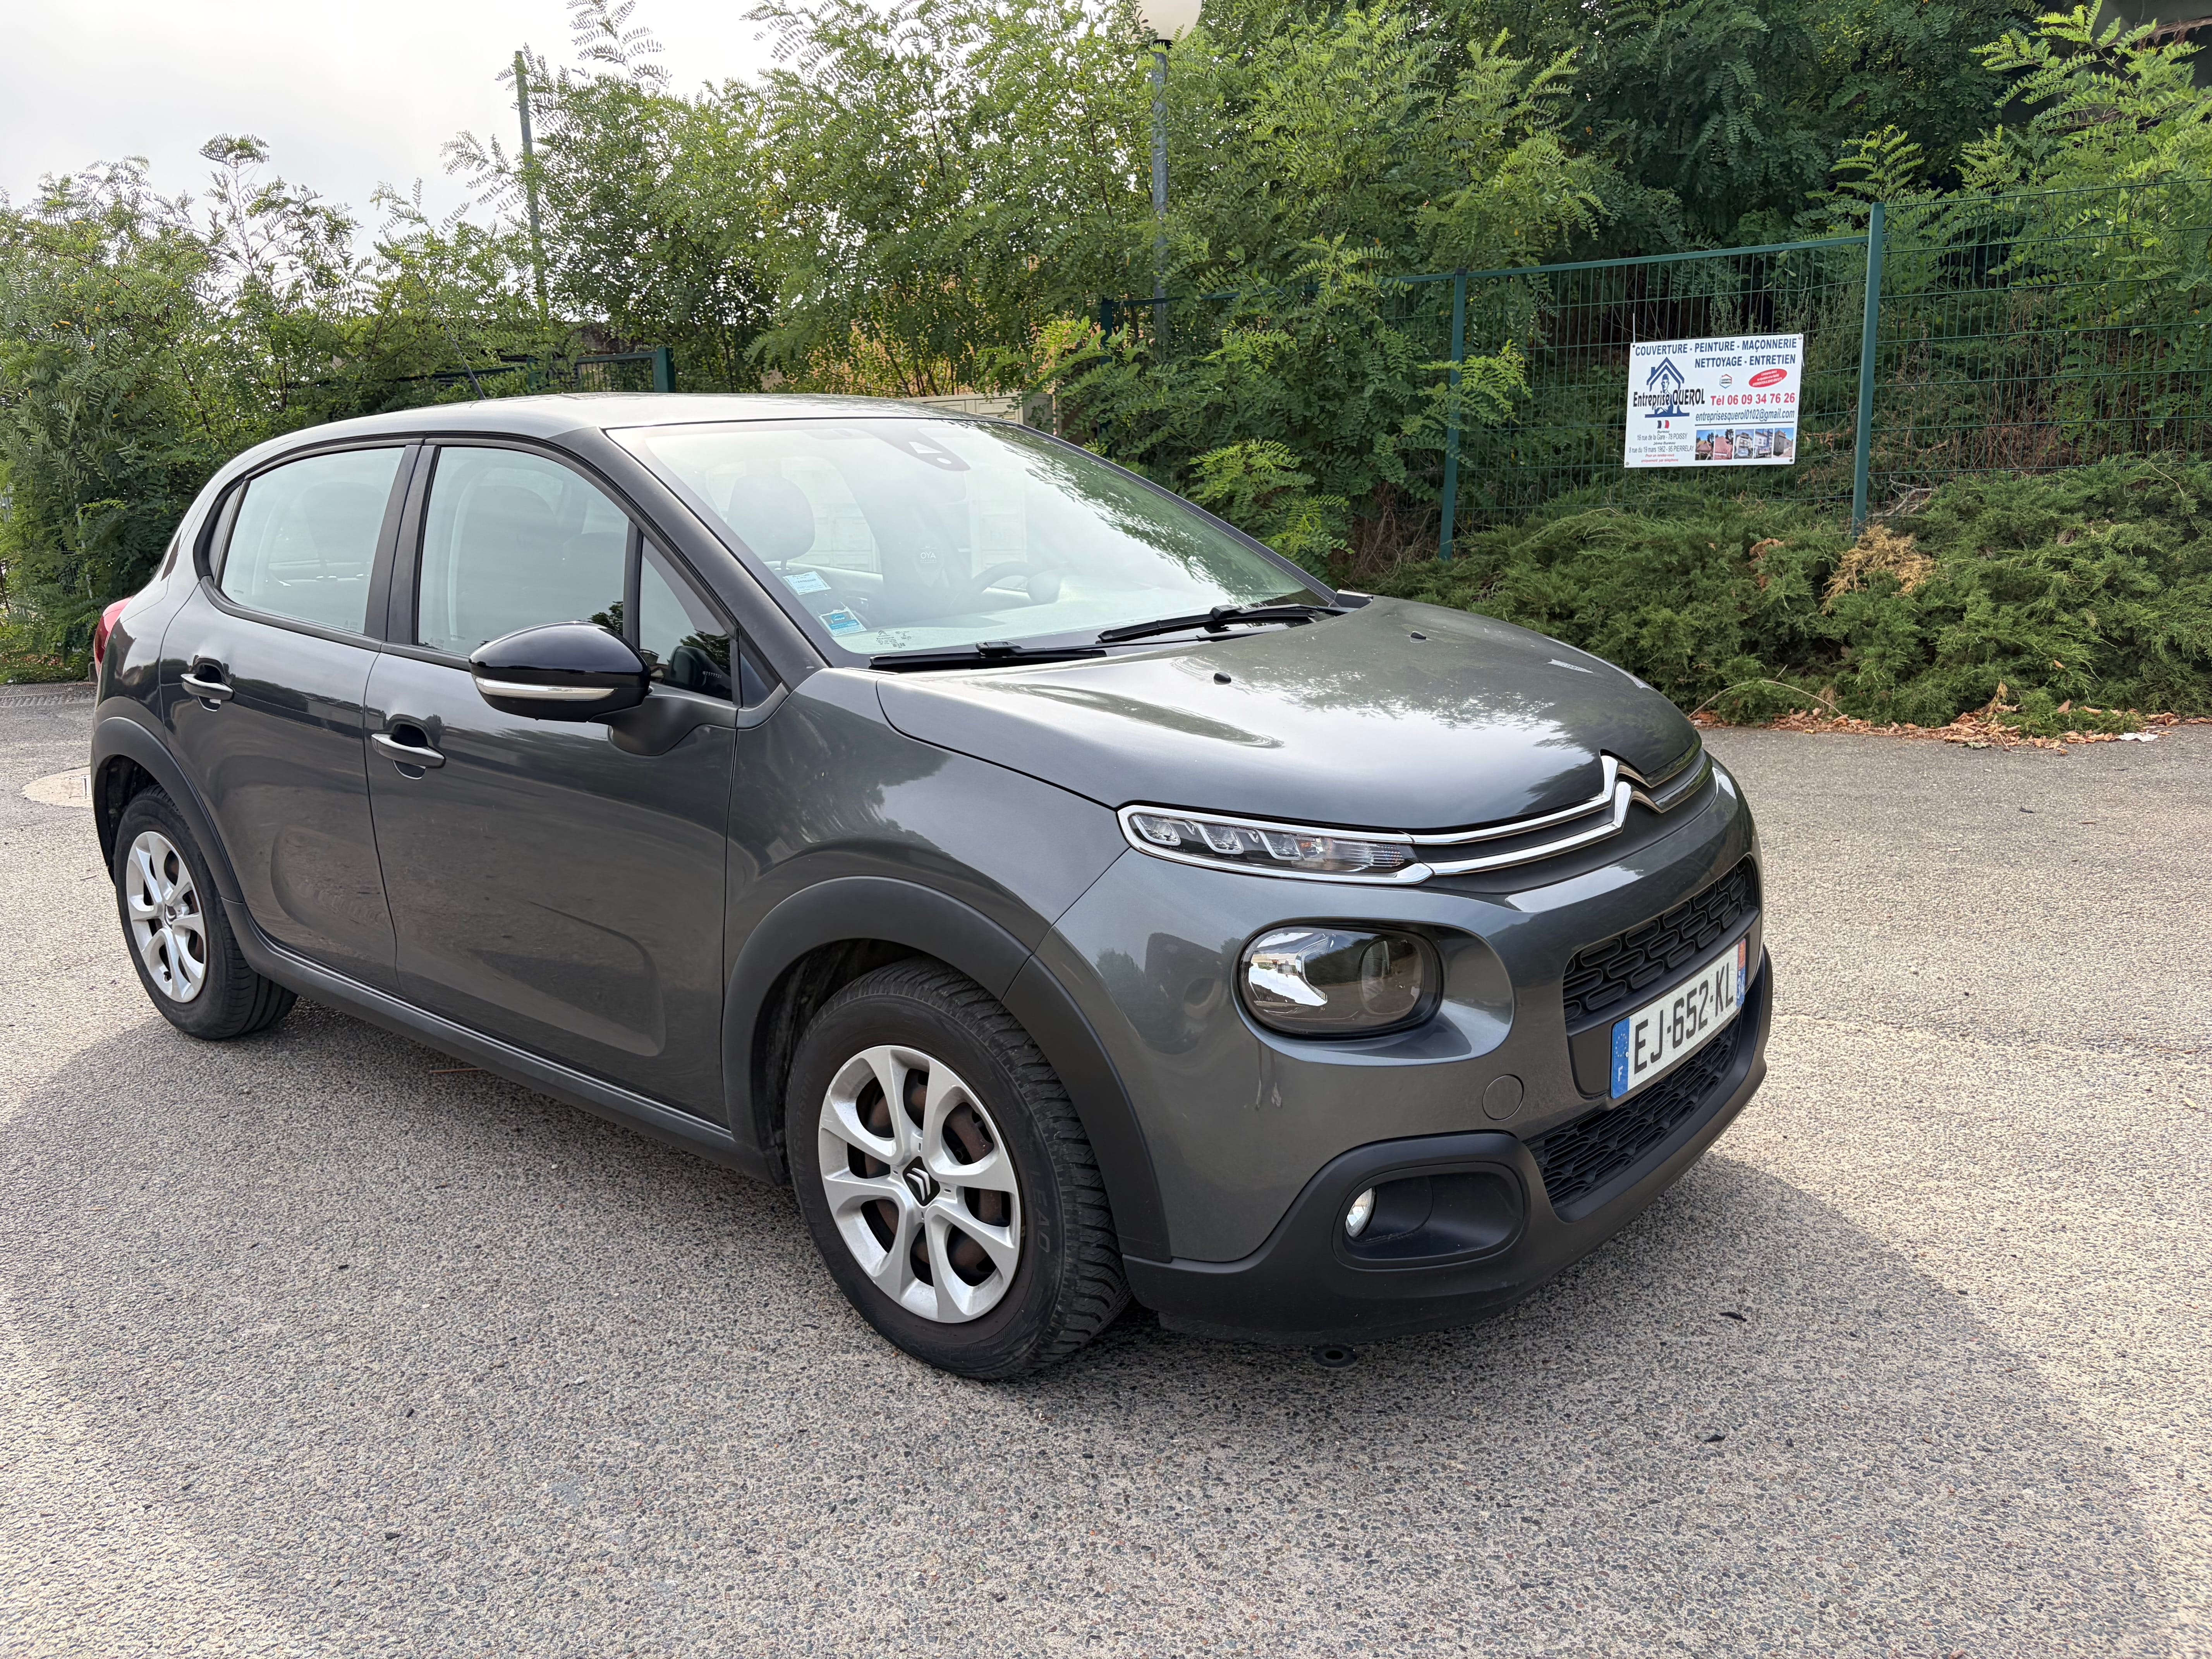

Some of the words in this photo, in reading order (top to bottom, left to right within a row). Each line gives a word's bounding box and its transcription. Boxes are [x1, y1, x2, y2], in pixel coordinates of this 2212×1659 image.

[1635, 343, 1688, 356] COUVERTURE
[1695, 341, 1735, 352] PEINTURE
[1742, 338, 1797, 352] MAÇONNERIE
[1695, 356, 1742, 368] NETTOYAGE
[1749, 354, 1796, 366] ENTRETIEN
[1633, 390, 1670, 410] Entreprise
[1673, 388, 1705, 406] QUEROL
[1711, 395, 1724, 405] Tél
[1727, 395, 1738, 405] 06
[1741, 394, 1752, 405] 09
[1755, 393, 1767, 404] 34
[1770, 393, 1781, 404] 76
[1784, 393, 1795, 403] 26
[1695, 408, 1795, 423] entreprisesquerol0102@gmail.com
[1634, 962, 1734, 1074] EJ-652-KL
[1618, 1065, 1623, 1082] F
[1027, 1168, 1051, 1253] LEAO
